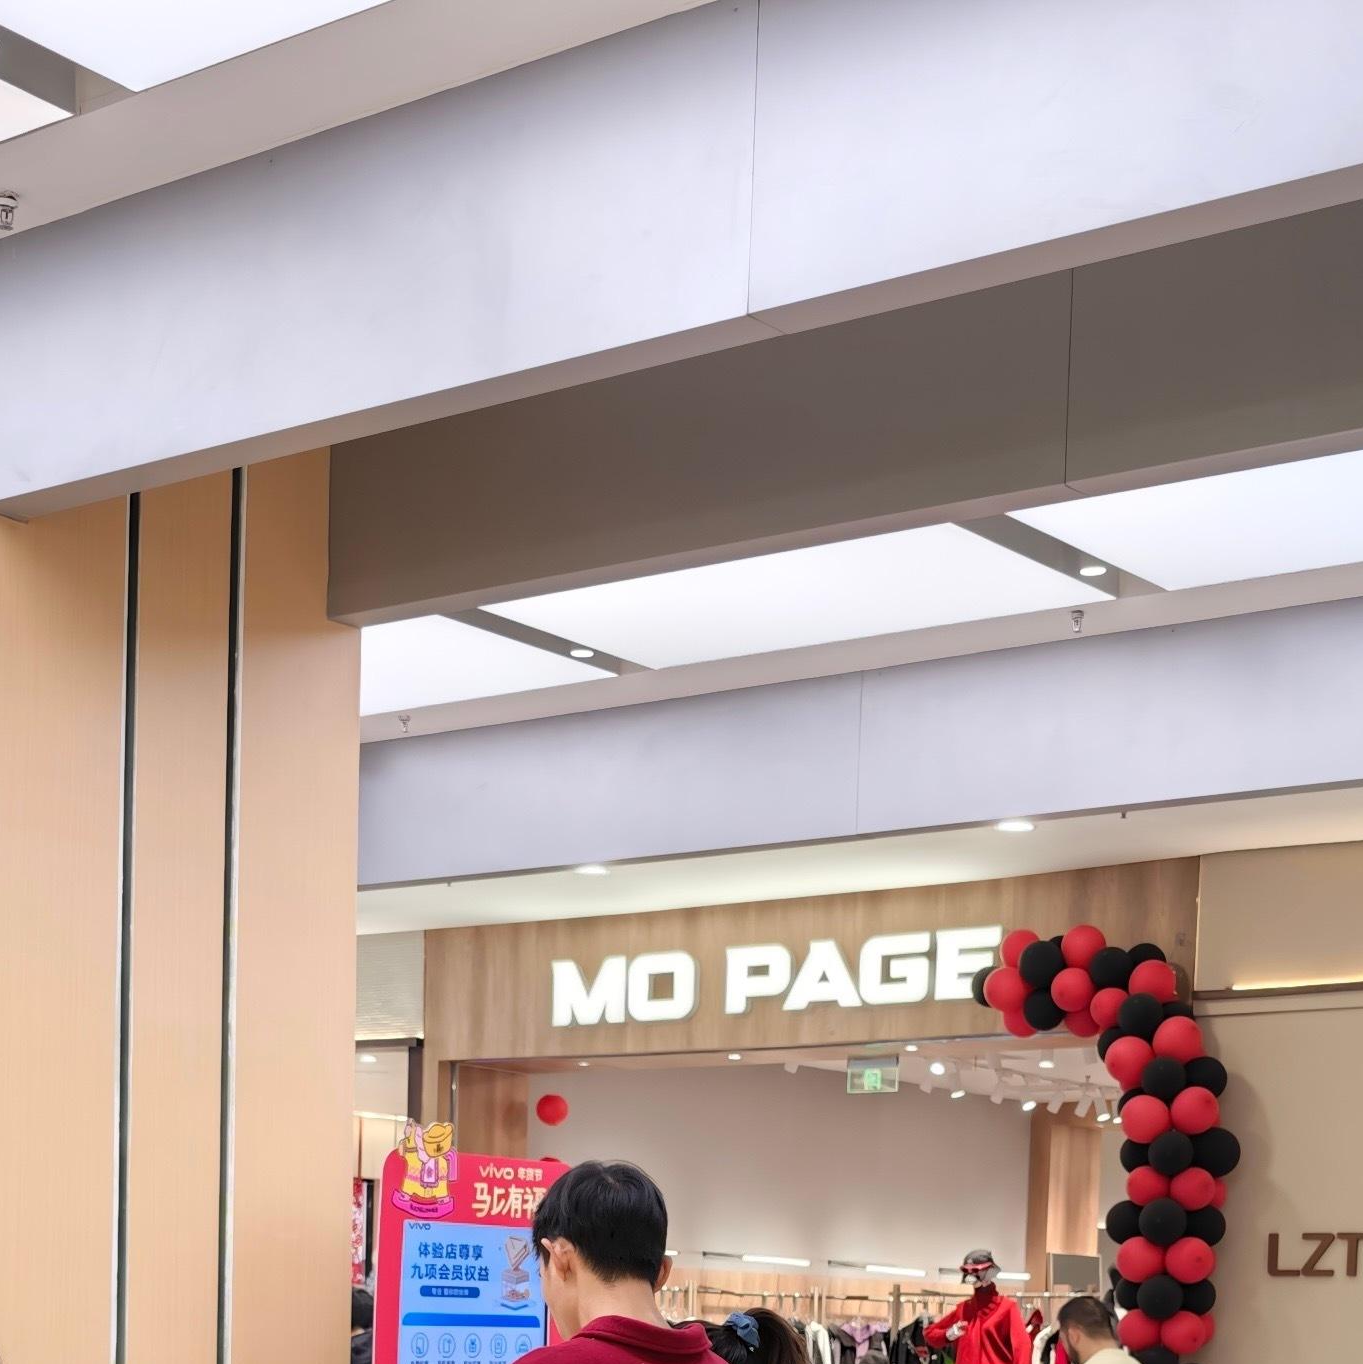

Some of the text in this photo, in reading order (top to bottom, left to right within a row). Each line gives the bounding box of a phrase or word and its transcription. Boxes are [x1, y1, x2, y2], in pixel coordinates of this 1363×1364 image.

[551, 924, 1004, 1027] MO PAGE
[479, 1163, 514, 1180] vivo
[409, 1222, 431, 1231] vivo
[418, 1242, 484, 1260] 体验店尊享
[411, 1264, 490, 1281] 九项会员权益
